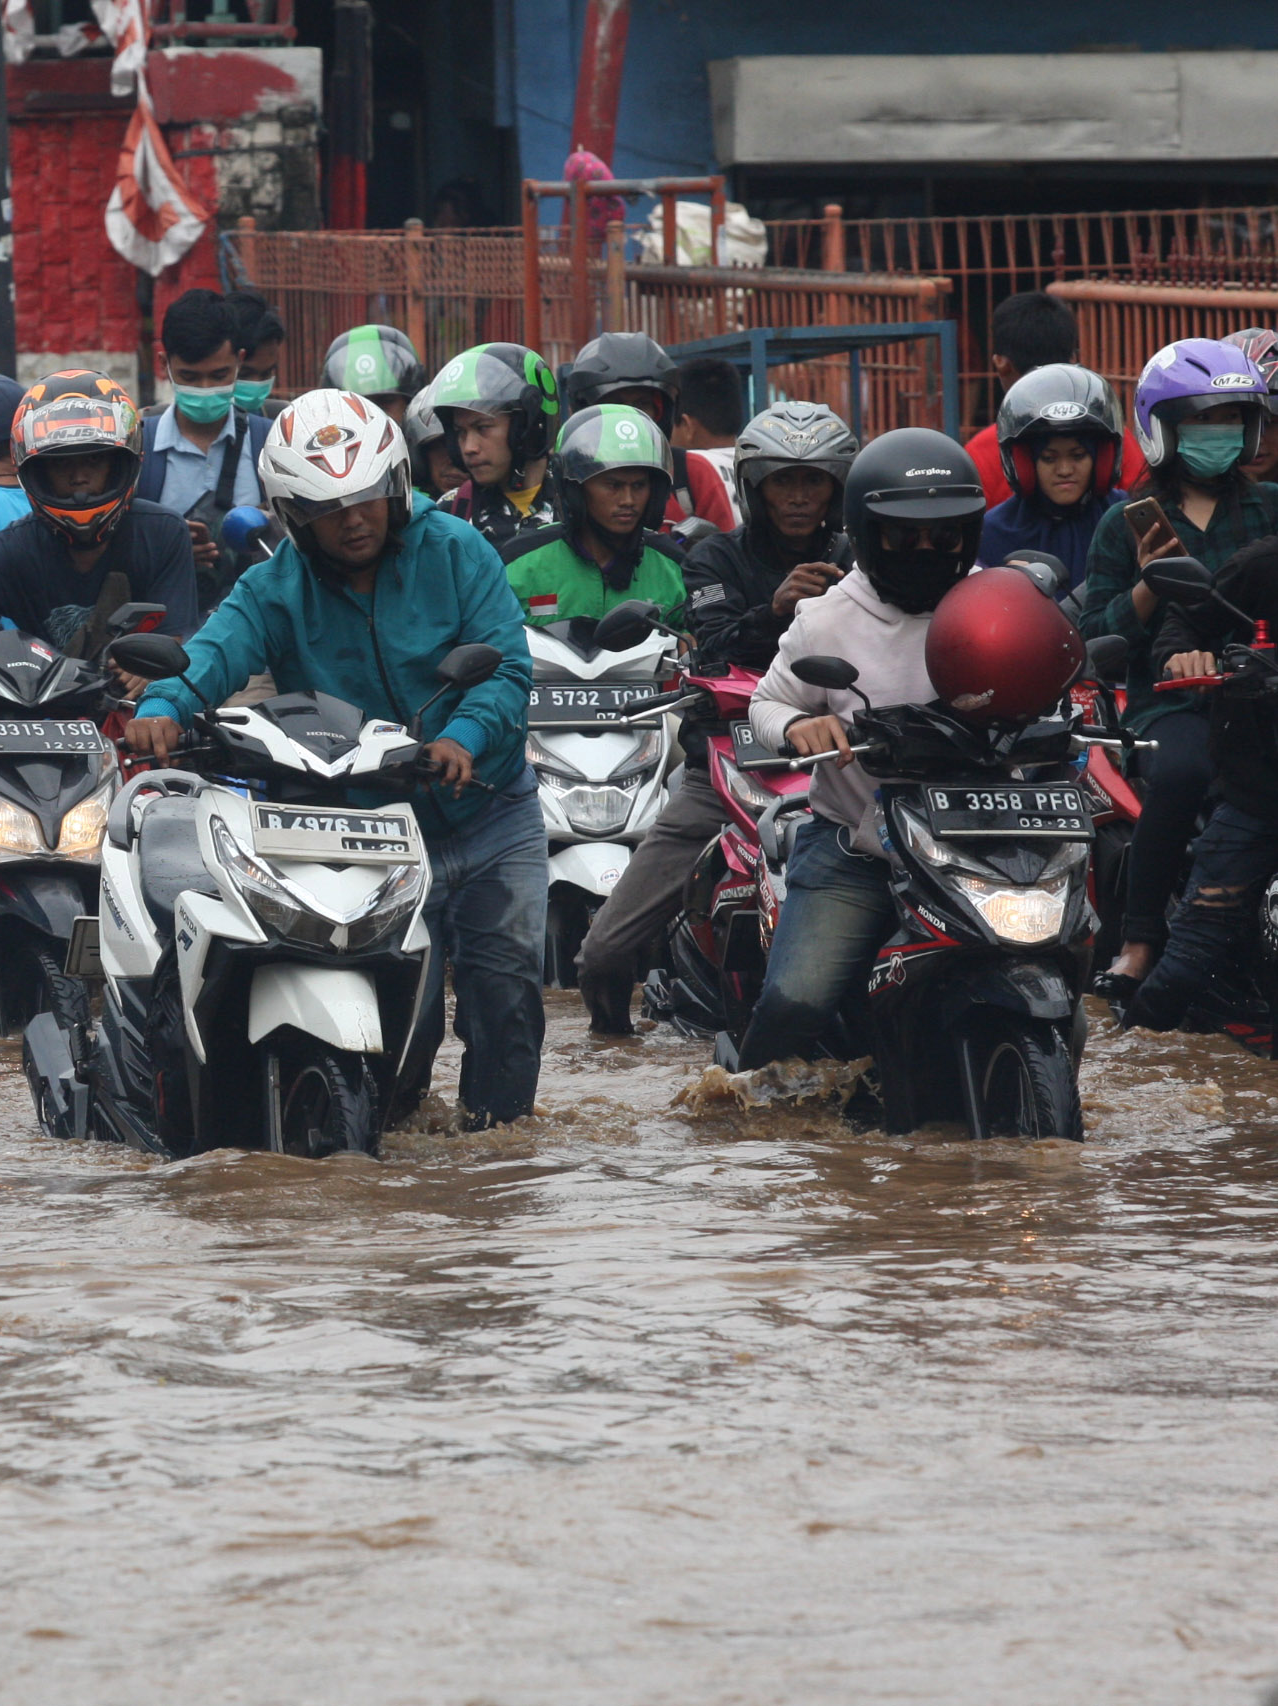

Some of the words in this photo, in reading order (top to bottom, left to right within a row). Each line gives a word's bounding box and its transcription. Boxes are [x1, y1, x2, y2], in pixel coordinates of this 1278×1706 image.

[6, 661, 42, 672] HONDA
[529, 691, 540, 706] B
[551, 690, 601, 706] 5732
[54, 722, 94, 736] TSG
[305, 731, 347, 740] HONDA
[740, 728, 754, 745] B
[1086, 772, 1113, 808] HONDA
[934, 791, 950, 810] B
[965, 793, 1023, 811] 3358
[1034, 792, 1079, 811] PFG
[736, 843, 758, 867] HONDA
[178, 905, 198, 937] HONDA
[917, 904, 947, 932] HONDA
